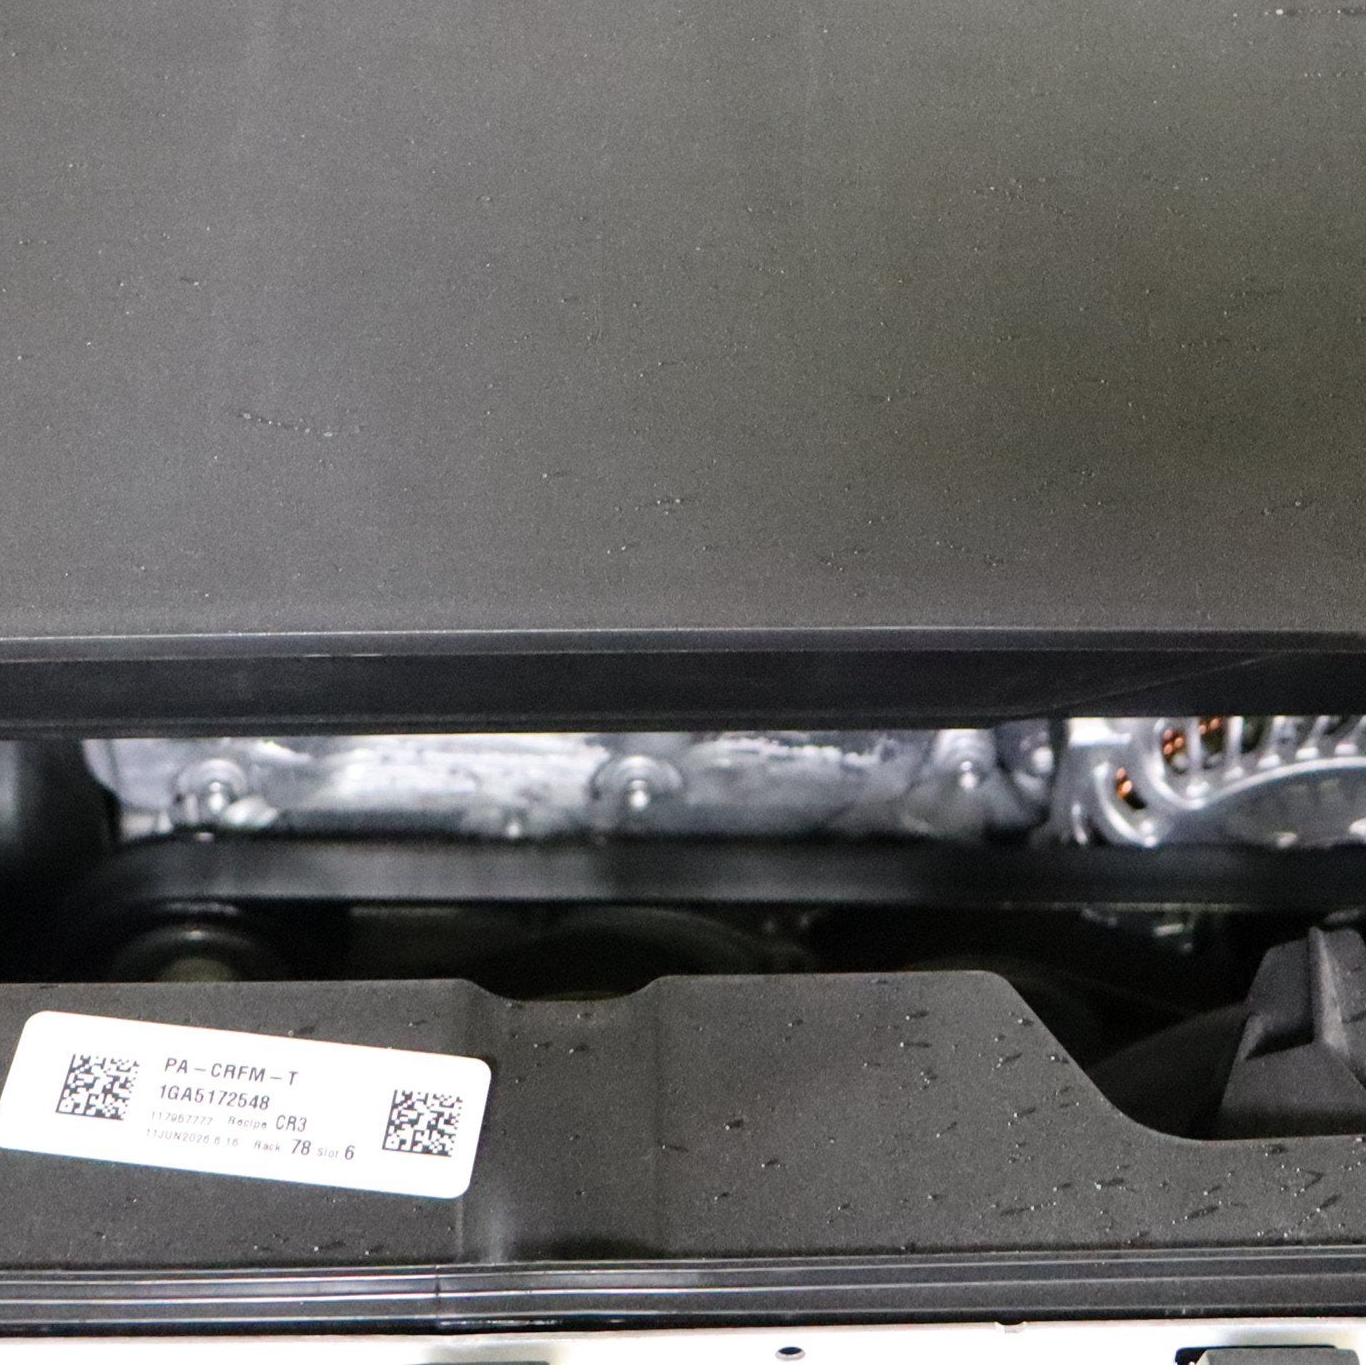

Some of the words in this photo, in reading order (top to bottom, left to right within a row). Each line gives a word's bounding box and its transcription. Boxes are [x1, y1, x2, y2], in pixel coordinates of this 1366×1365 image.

[159, 1084, 271, 1110] 1GA5172548
[228, 1115, 268, 1130] Recipe
[275, 1114, 308, 1133] CR3
[253, 1139, 282, 1153] Rack
[291, 1138, 312, 1156] 78
[316, 1146, 339, 1159] Slot
[344, 1144, 356, 1161] 6
